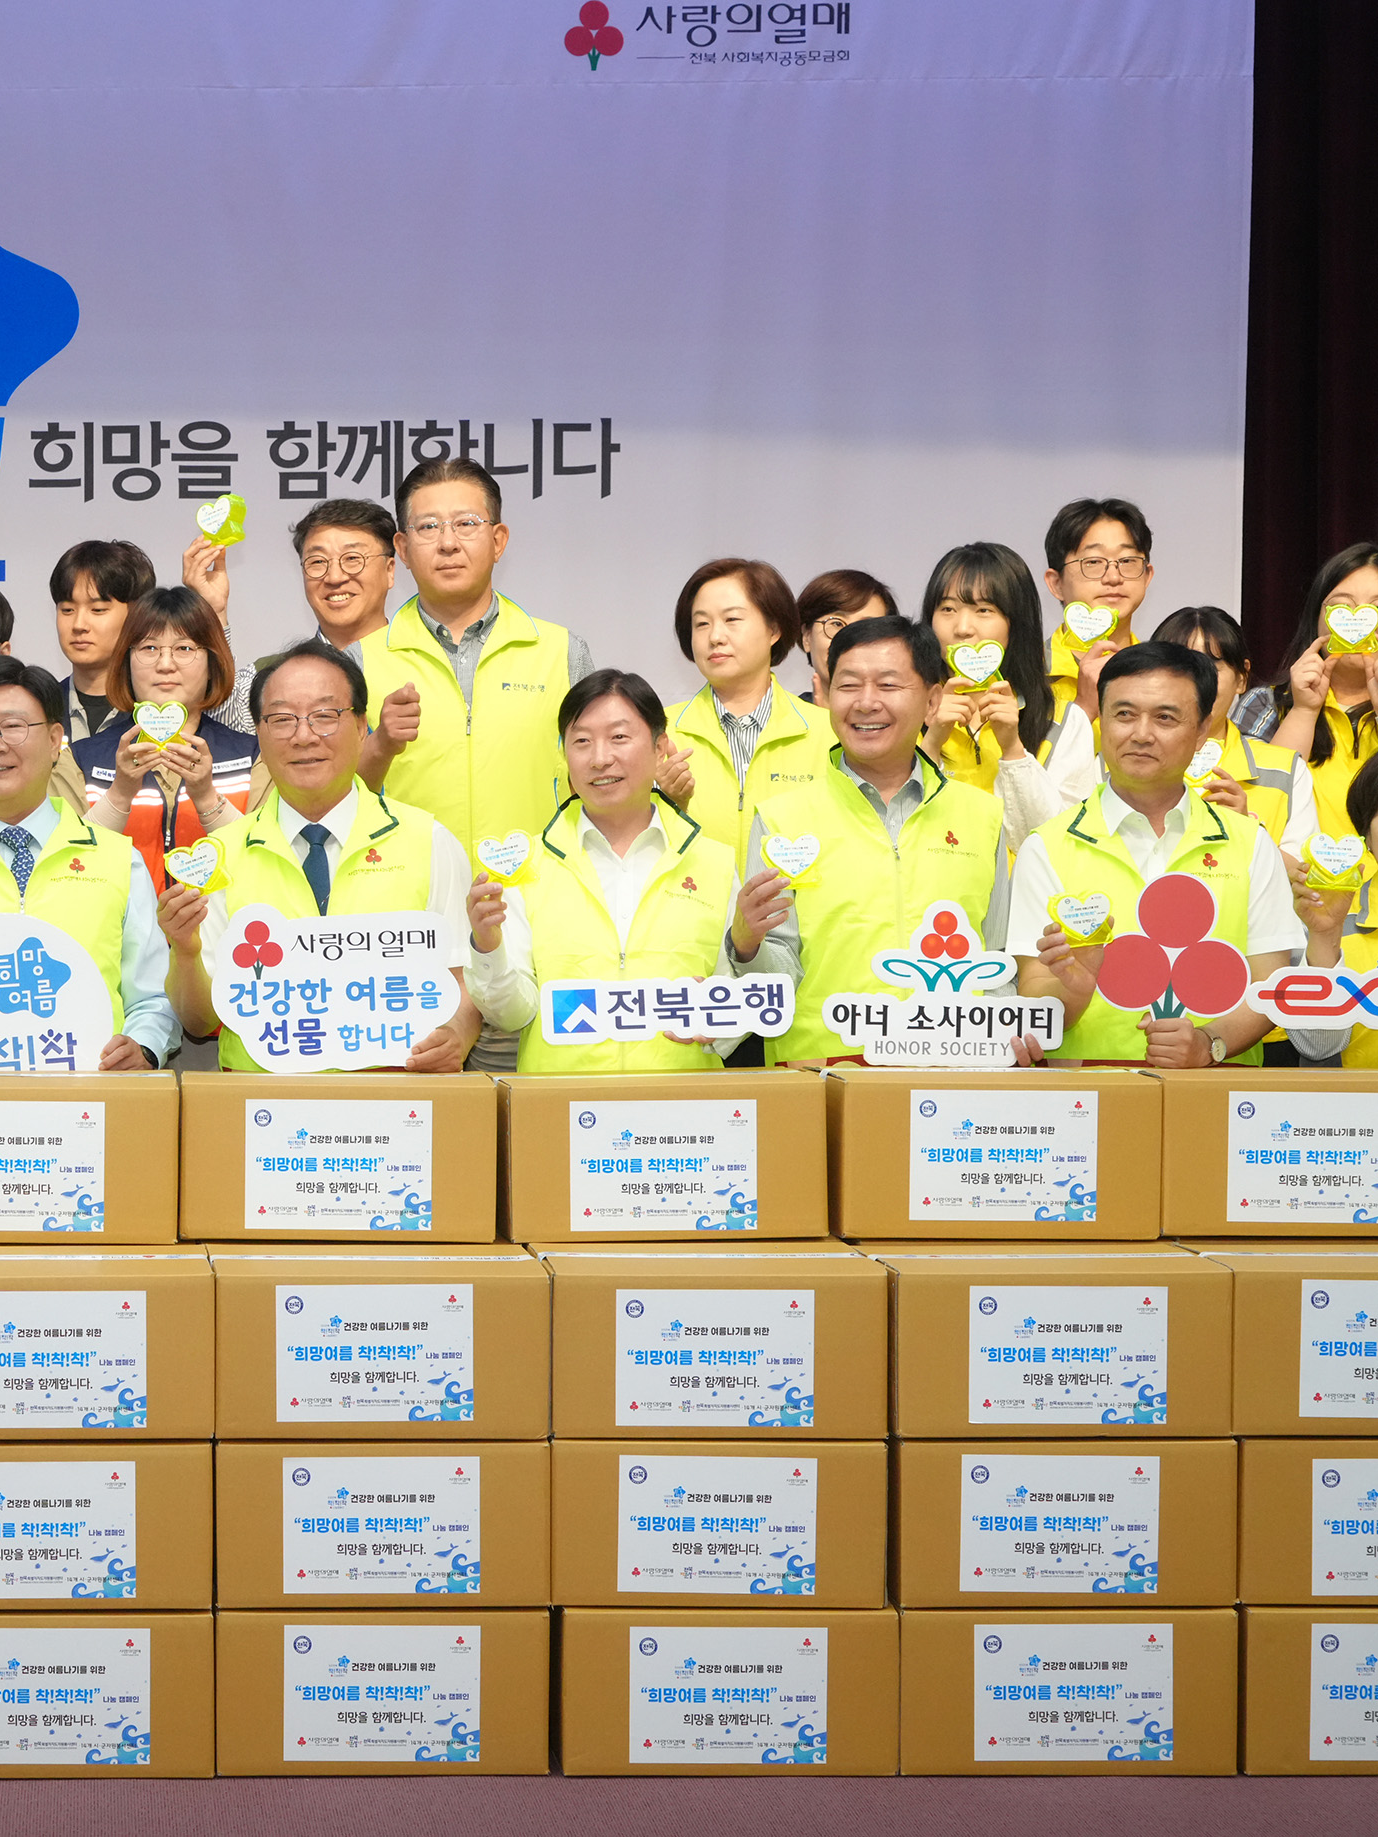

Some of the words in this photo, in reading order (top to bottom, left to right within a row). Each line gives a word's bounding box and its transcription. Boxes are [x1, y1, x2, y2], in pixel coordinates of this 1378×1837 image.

[636, 3, 850, 47] 사랑의열매
[689, 53, 716, 64] 전북
[722, 50, 850, 67] 사회복지공동모금회
[28, 418, 239, 502] 희망을
[8, 979, 56, 1011] 여름
[228, 977, 330, 1018] 건강한
[345, 976, 443, 1014] 여름을
[607, 982, 784, 1029] 전북은행
[831, 1004, 890, 1038] 아너
[907, 1004, 1053, 1039] 소사이어티
[258, 1018, 326, 1058] 선물
[337, 1023, 415, 1053] 합니다
[874, 1040, 935, 1056] HONOR
[940, 1040, 1010, 1056] SOCIETY
[973, 1124, 997, 1134] 건강한
[1000, 1126, 1037, 1134] 여름나기를
[375, 1136, 389, 1144] 위한
[961, 1173, 990, 1184] 희망을
[994, 1173, 1045, 1184] 함께합니다.
[296, 1182, 325, 1193] 희망을
[329, 1182, 380, 1193] 함께합니다.
[685, 1327, 708, 1335] 건강한
[711, 1327, 750, 1335] 여름나기를
[754, 1327, 769, 1336] 위한
[670, 1376, 700, 1388] 희망을
[705, 1376, 759, 1388] 함께합니다.
[351, 1495, 374, 1503] 건강한
[377, 1494, 416, 1503] 여름나기를
[420, 1494, 435, 1503] 위한
[337, 1544, 367, 1556] 희망을
[372, 1544, 426, 1555] 함께합니다.
[1043, 1662, 1066, 1670] 건강한
[1069, 1662, 1109, 1670] 여름나기를
[1112, 1662, 1127, 1670] 위한
[1029, 1711, 1059, 1723] 희망을
[1064, 1711, 1118, 1722] 함께합니다.
